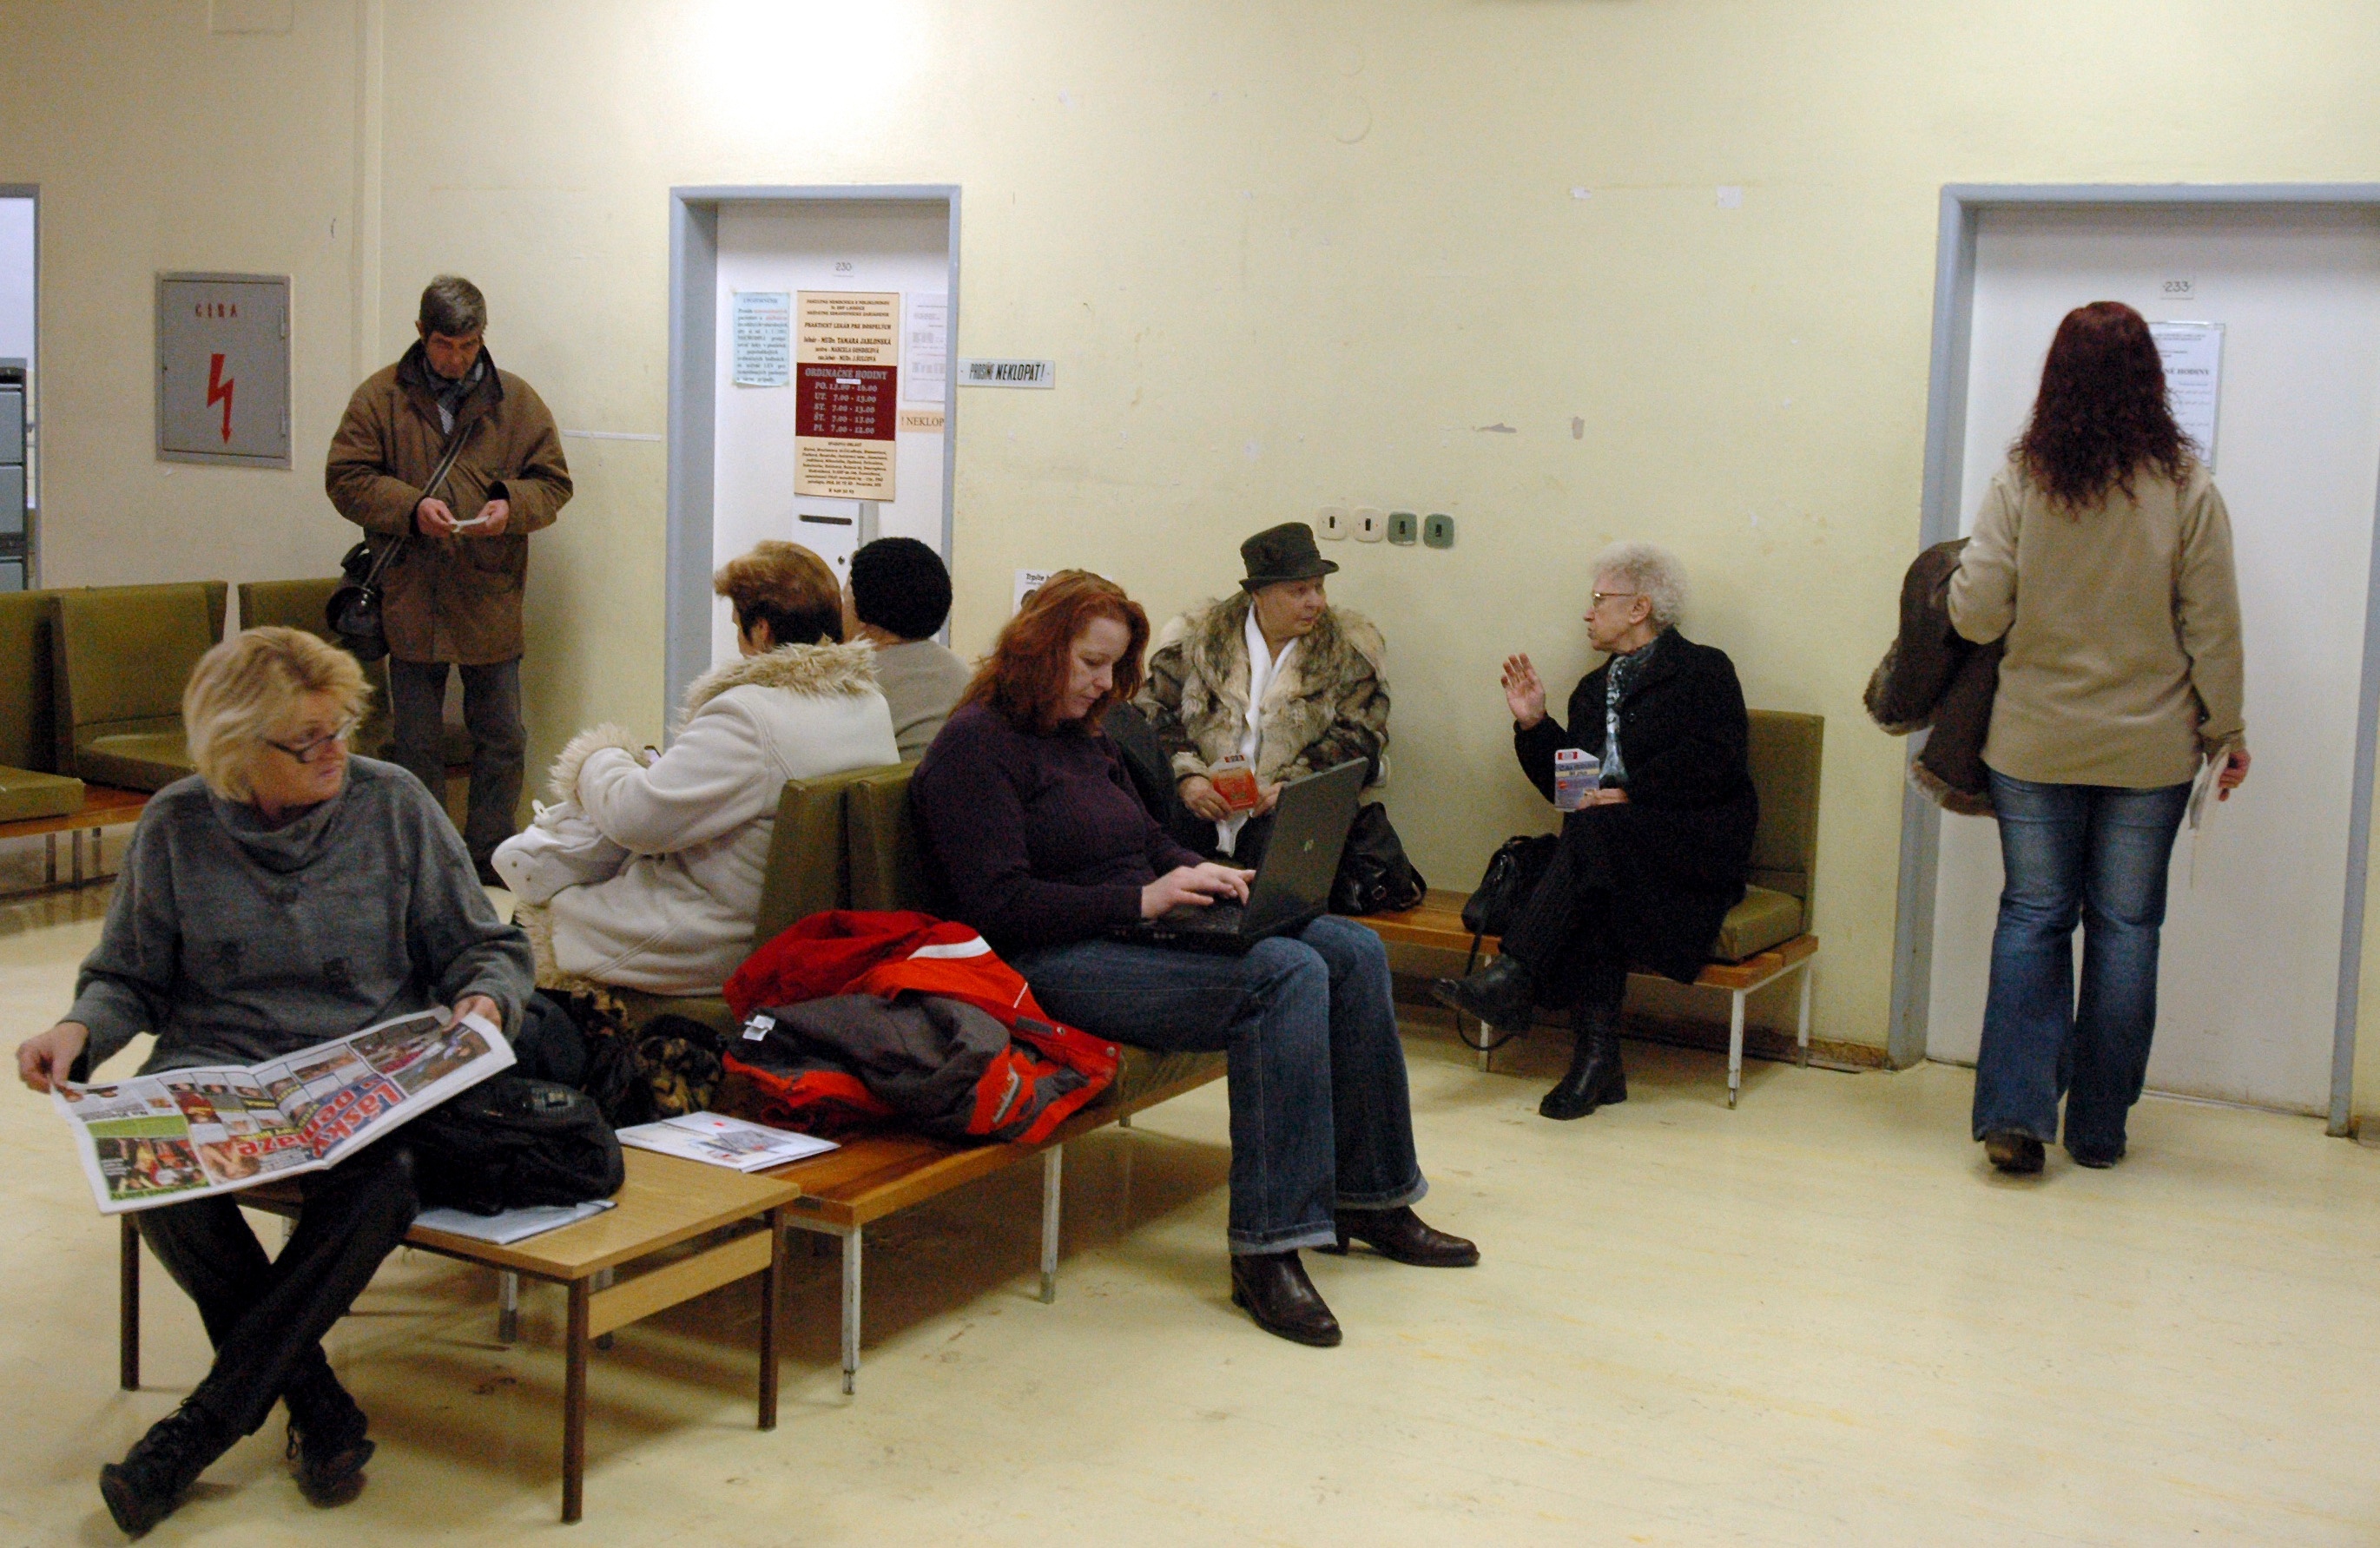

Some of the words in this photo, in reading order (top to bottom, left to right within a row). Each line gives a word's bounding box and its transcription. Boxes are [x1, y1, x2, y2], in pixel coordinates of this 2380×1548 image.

[834, 262, 853, 272] 230
[2164, 280, 2190, 293] 233
[805, 366, 854, 379] ORDINAČNÉ
[855, 370, 888, 380] HODINY
